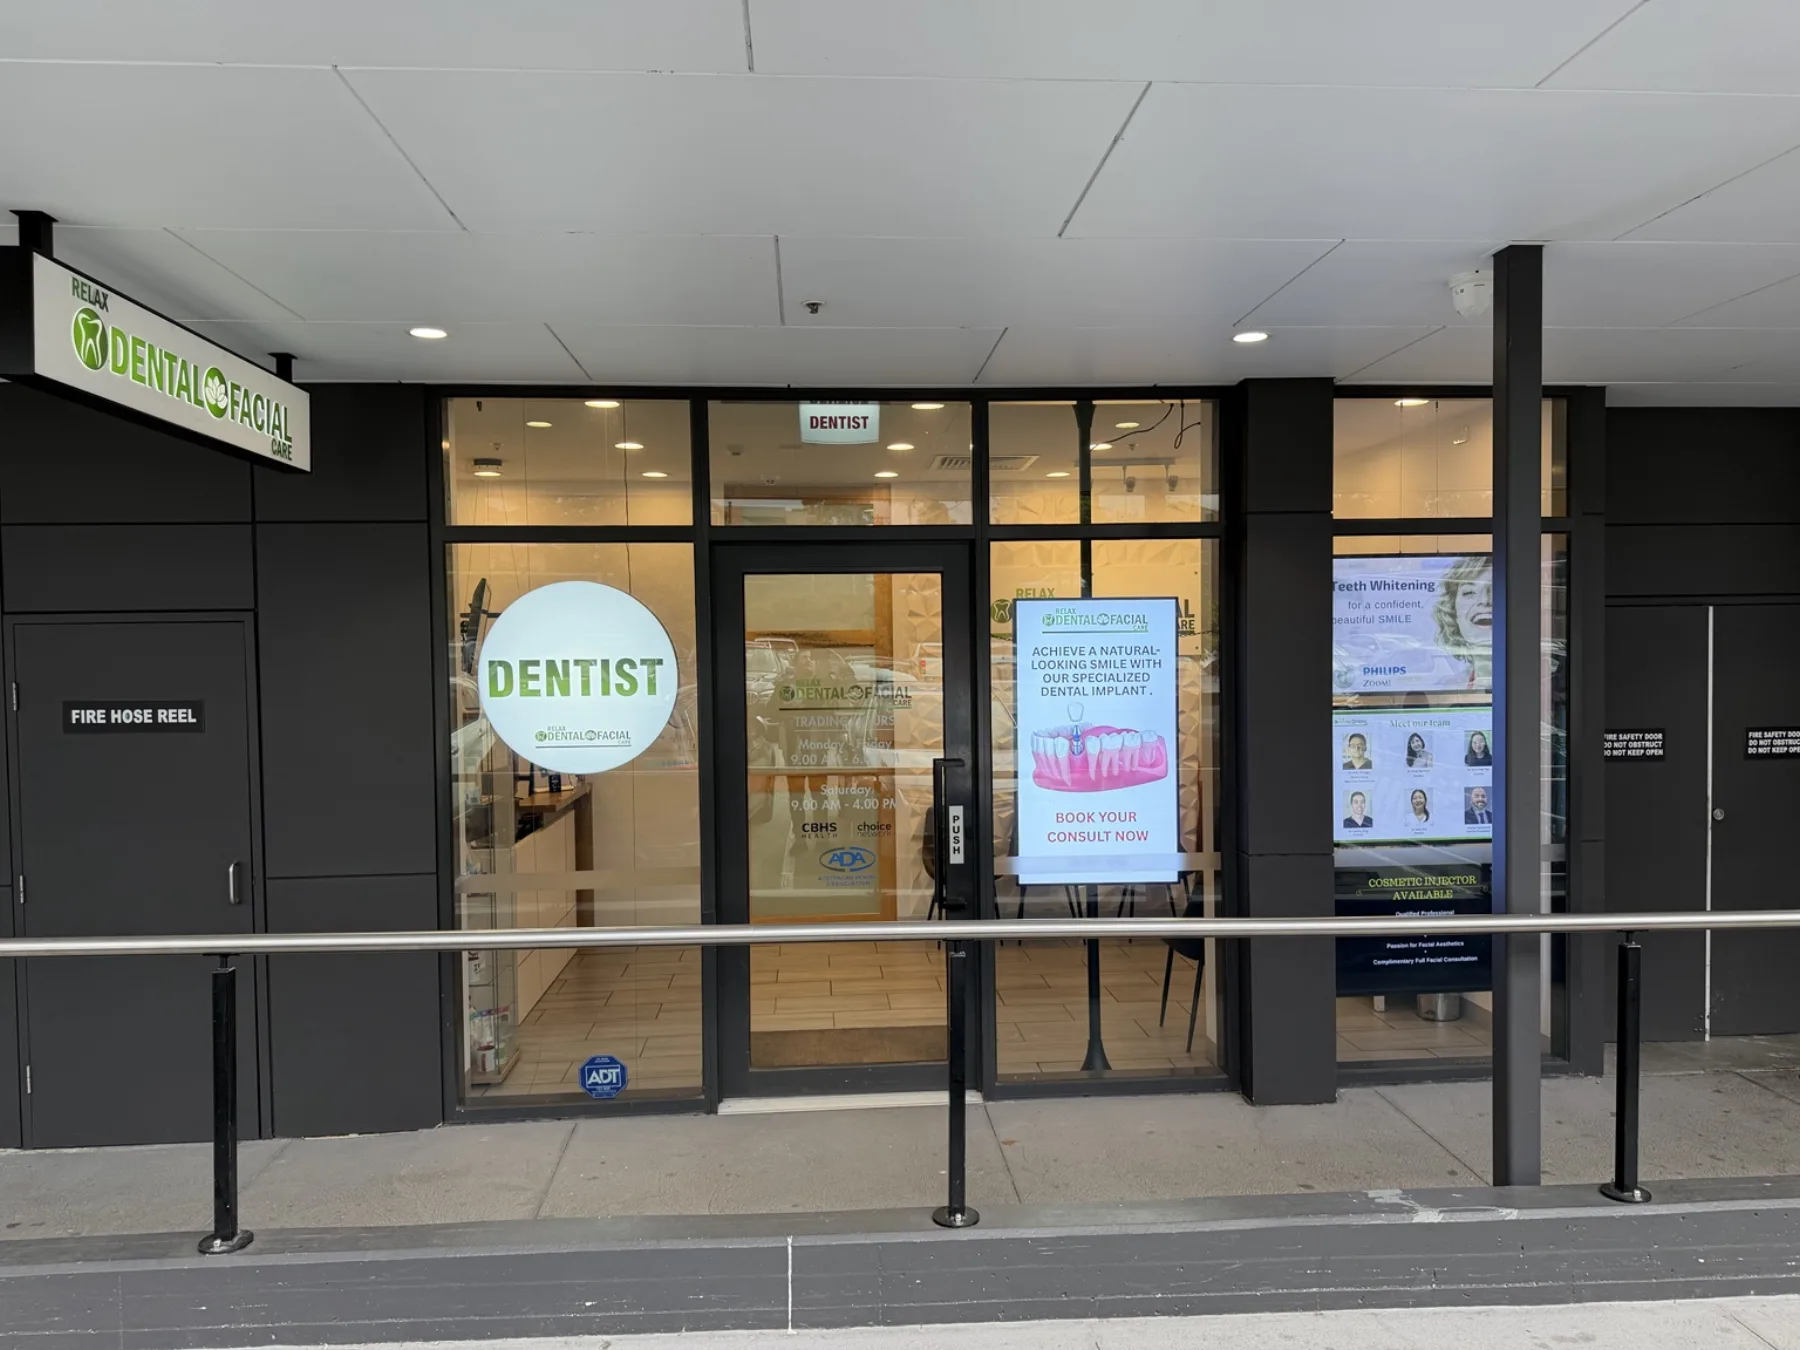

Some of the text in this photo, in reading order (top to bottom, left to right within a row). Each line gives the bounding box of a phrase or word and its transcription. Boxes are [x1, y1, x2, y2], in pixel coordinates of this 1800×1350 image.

[71, 277, 110, 312] RELAX
[108, 325, 293, 444] DENTAL FACIAL
[809, 415, 869, 430] DENTIST
[270, 438, 293, 461] CARE
[1333, 579, 1435, 593] Teeth Whitening
[1016, 587, 1056, 599] RELAX
[1348, 600, 1361, 609] for
[1056, 613, 1148, 626] DENTAL FACIAL
[1177, 619, 1195, 630] ARE
[1378, 614, 1412, 624] SMILE
[1032, 645, 1160, 657] ACHIEVE A NATURAL-
[1031, 659, 1162, 670] LOOKING SMILE WITH
[1363, 666, 1406, 676] PHILIPS
[488, 657, 664, 698] DENTIST
[1043, 672, 1150, 683] OUR SPECIALIZED
[796, 680, 822, 688] RELAX
[796, 687, 848, 700] DENTAL
[1041, 687, 1089, 697] DENTAL
[1092, 686, 1147, 696] IMPLANT
[71, 708, 197, 724] FIRE HOSE REEL
[795, 715, 848, 727] TRADING
[1389, 719, 1411, 728] Meet
[1430, 719, 1450, 727] team
[547, 730, 631, 741] DENTAL FACIAL
[1644, 732, 1663, 740] DOOR
[798, 738, 892, 753] Monday Fday
[1613, 741, 1627, 749] NOT
[1628, 741, 1663, 749] OBSTRUCT
[1772, 738, 1800, 746] OBSTRUC
[1612, 749, 1626, 757] NOT
[791, 754, 817, 765] 9.00
[791, 799, 818, 811] 9.00
[821, 799, 841, 811] AM
[853, 799, 879, 810] 4.00
[1056, 811, 1137, 824] BOOK YOUR
[801, 821, 892, 832] CBHS choice
[952, 815, 960, 855] PUSH
[1047, 830, 1149, 842] CONSULT NOW
[828, 851, 866, 867] ADA
[1368, 875, 1477, 888] COSMETIC INJECTOR
[1393, 890, 1453, 900] AVAILABLE
[1373, 958, 1414, 966] Complimentary
[1444, 955, 1478, 963] Consultation
[587, 1068, 620, 1085] ADT
